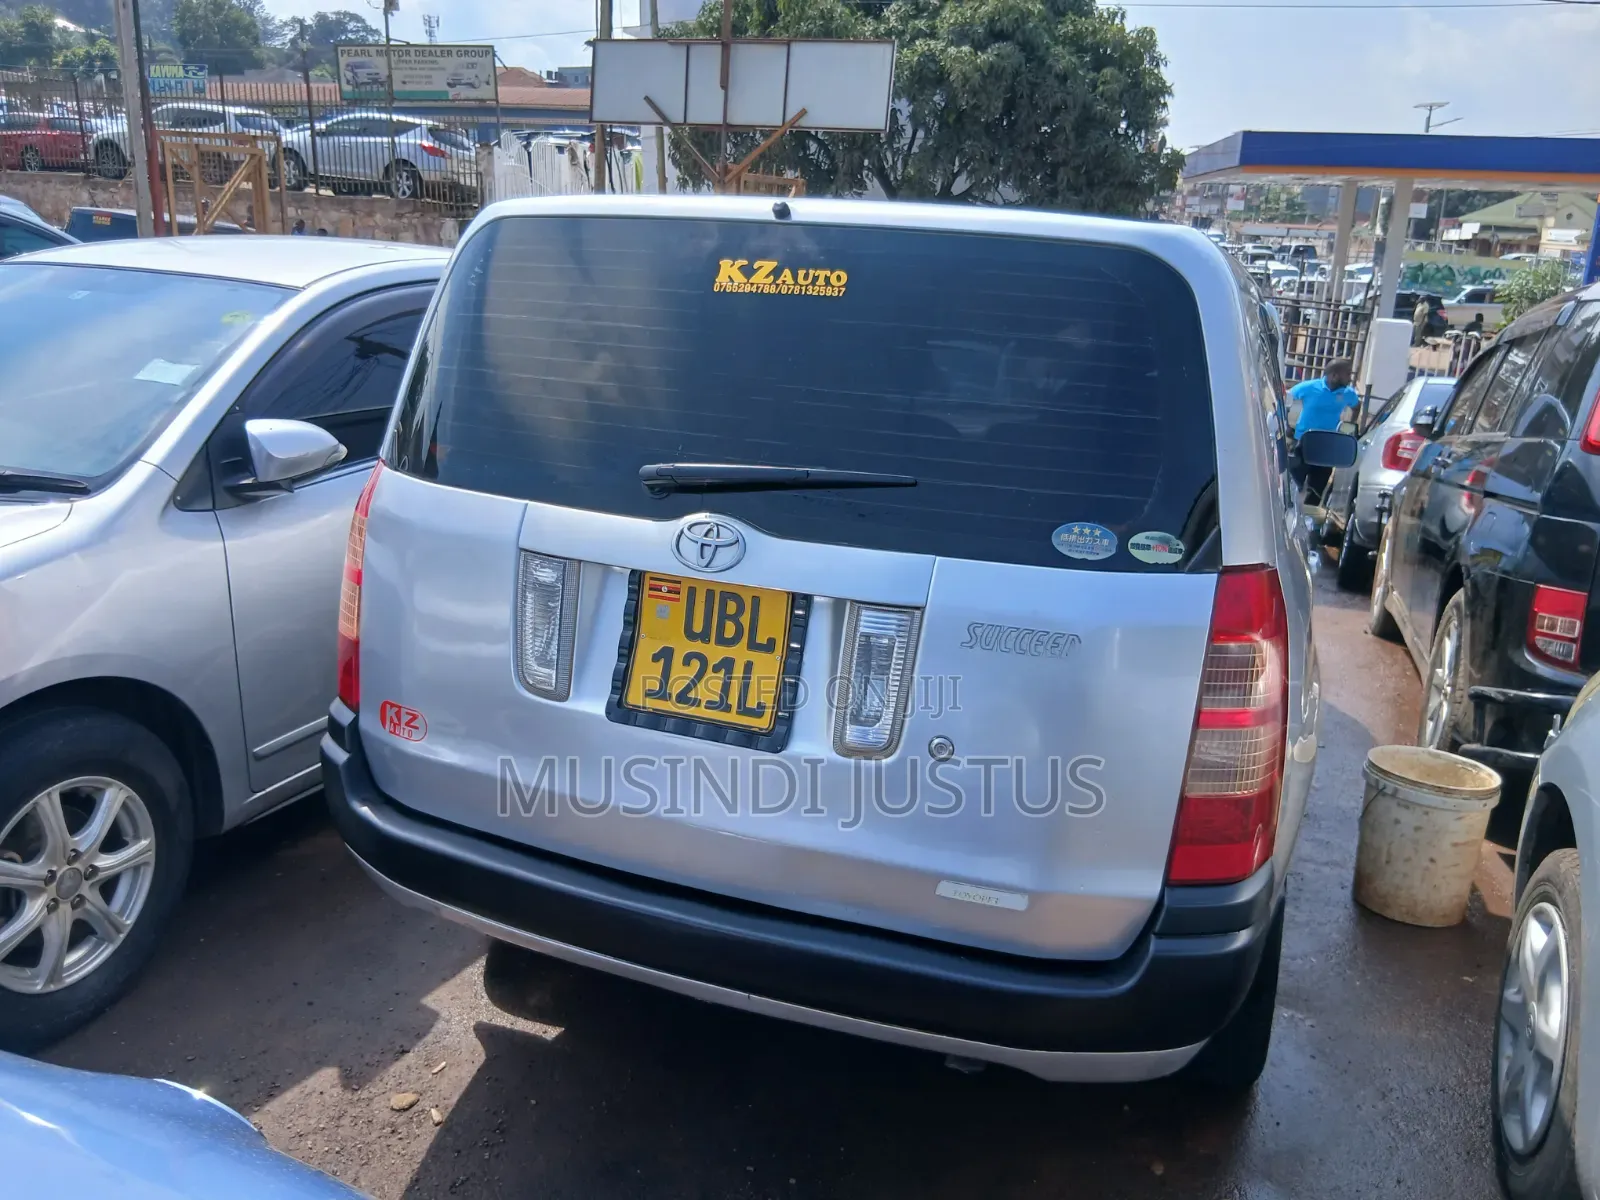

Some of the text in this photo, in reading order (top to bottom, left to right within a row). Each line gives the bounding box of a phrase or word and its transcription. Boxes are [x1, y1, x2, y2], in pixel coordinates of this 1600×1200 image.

[340, 49, 373, 58] PEARL
[414, 49, 453, 58] DEALER
[456, 50, 491, 59] GROUP
[683, 586, 776, 654] UBL
[644, 645, 767, 718] 121L
